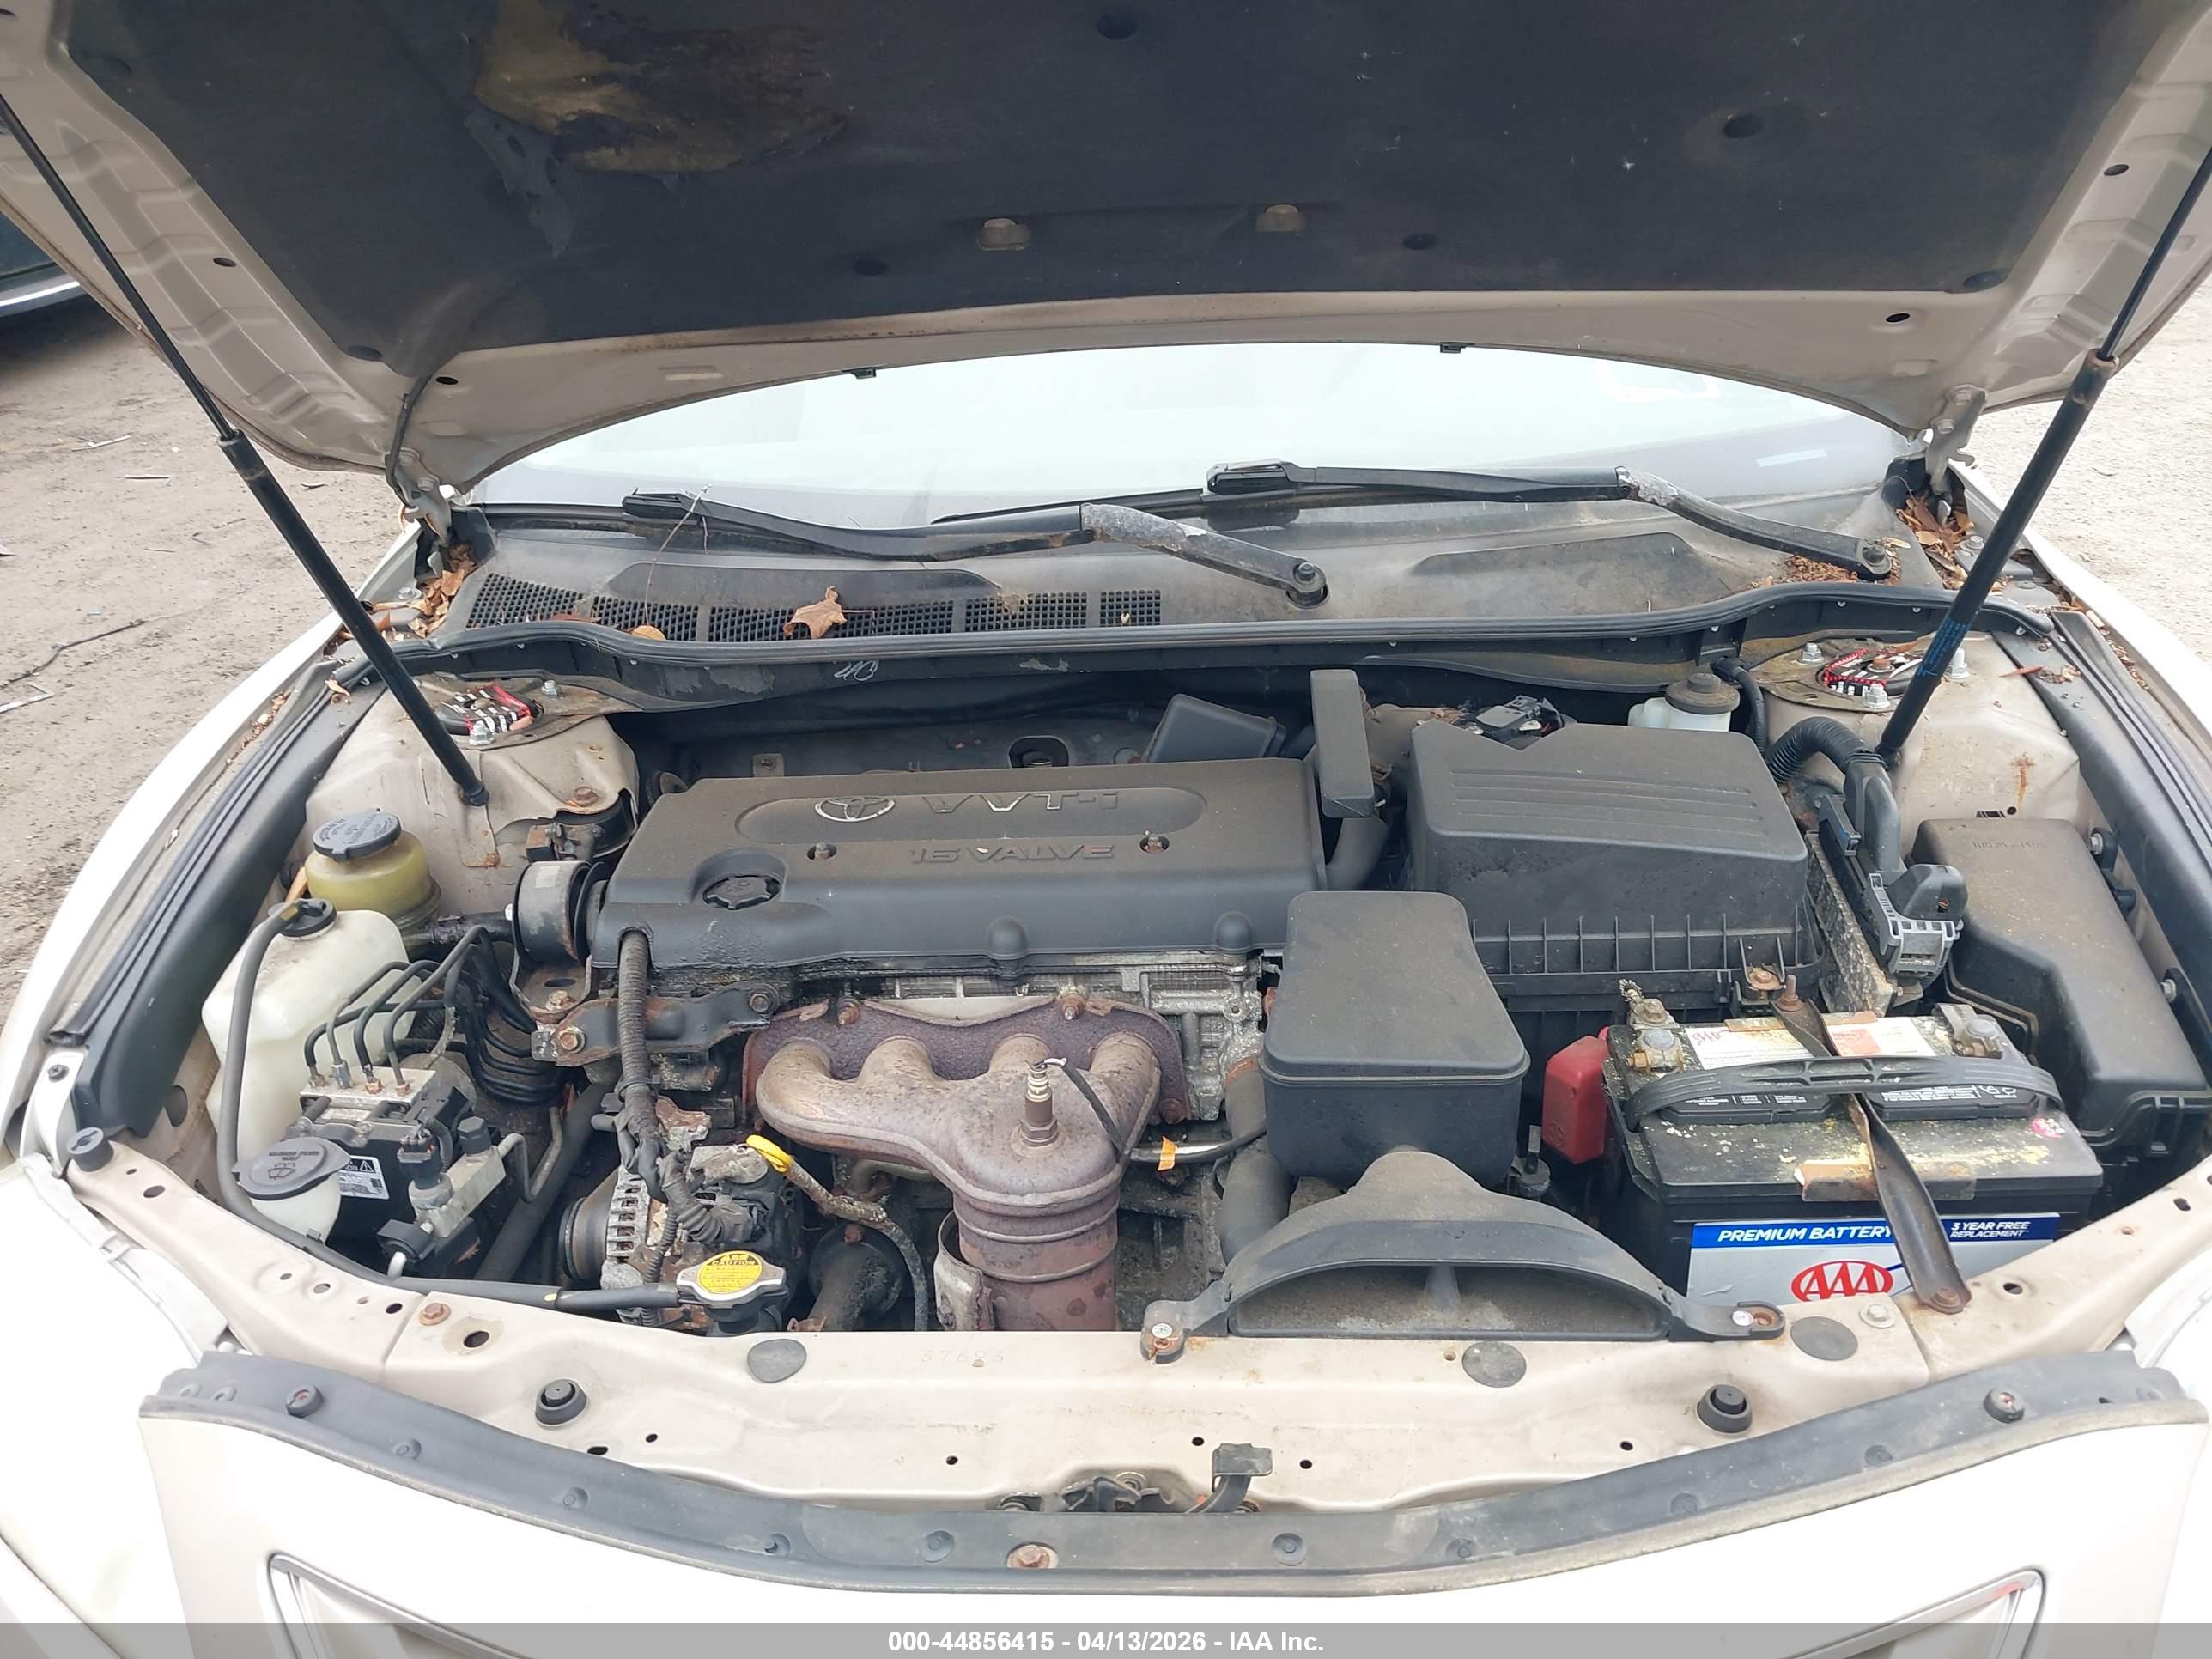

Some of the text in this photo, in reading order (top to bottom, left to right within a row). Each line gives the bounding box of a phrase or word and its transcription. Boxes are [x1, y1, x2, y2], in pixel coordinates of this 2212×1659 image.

[910, 843, 1115, 864] 16 VALVE
[1717, 1225, 1892, 1243] PREMIUM BATTERY
[1951, 1221, 2032, 1231] 3 YEAR FREE
[1796, 1261, 1889, 1300] AAA
